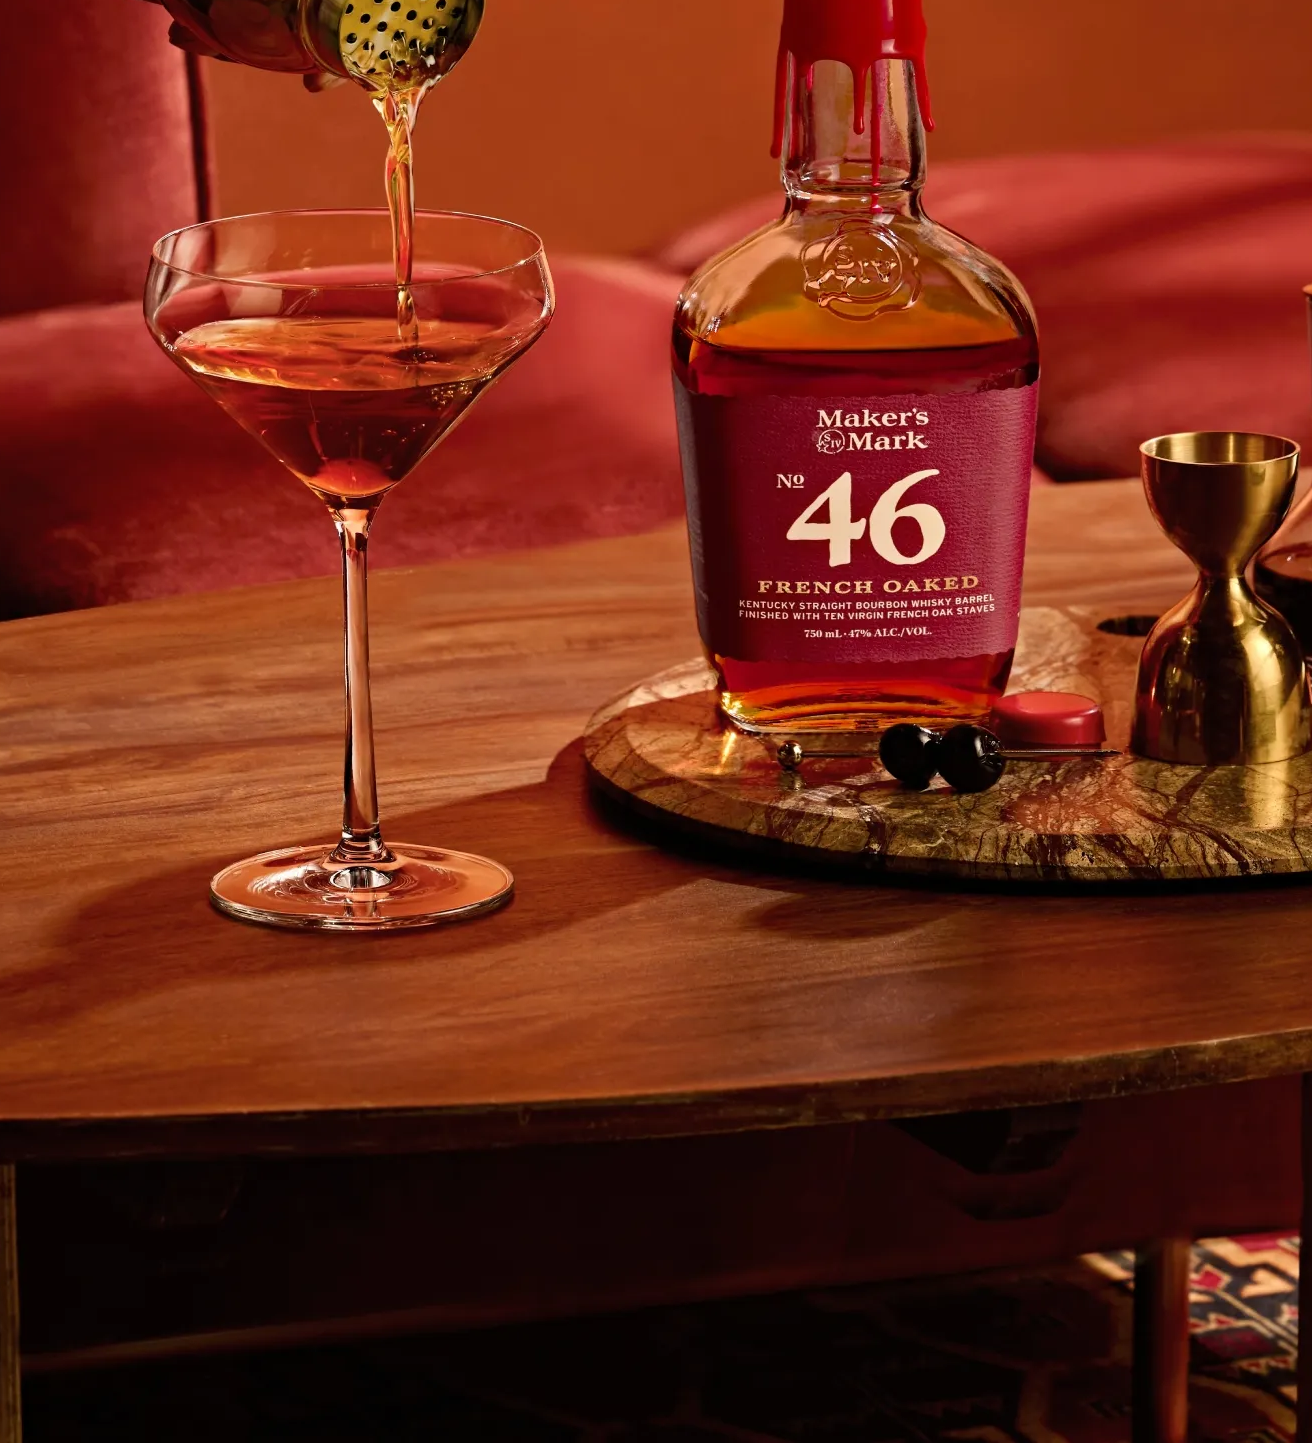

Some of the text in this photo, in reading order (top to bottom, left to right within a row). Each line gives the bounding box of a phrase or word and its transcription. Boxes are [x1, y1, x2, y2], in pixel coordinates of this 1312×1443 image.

[816, 408, 929, 428] Maker's
[786, 468, 946, 567] 46
[757, 575, 979, 594] FRENCH OAKED
[739, 594, 995, 610] KENTUCKY STRAIGHT BOURBON WHISKY BARREL
[739, 603, 995, 620] FINISHED WITH TEN VIRGIN FRENCH OAK STAVES
[804, 629, 823, 638] 750
